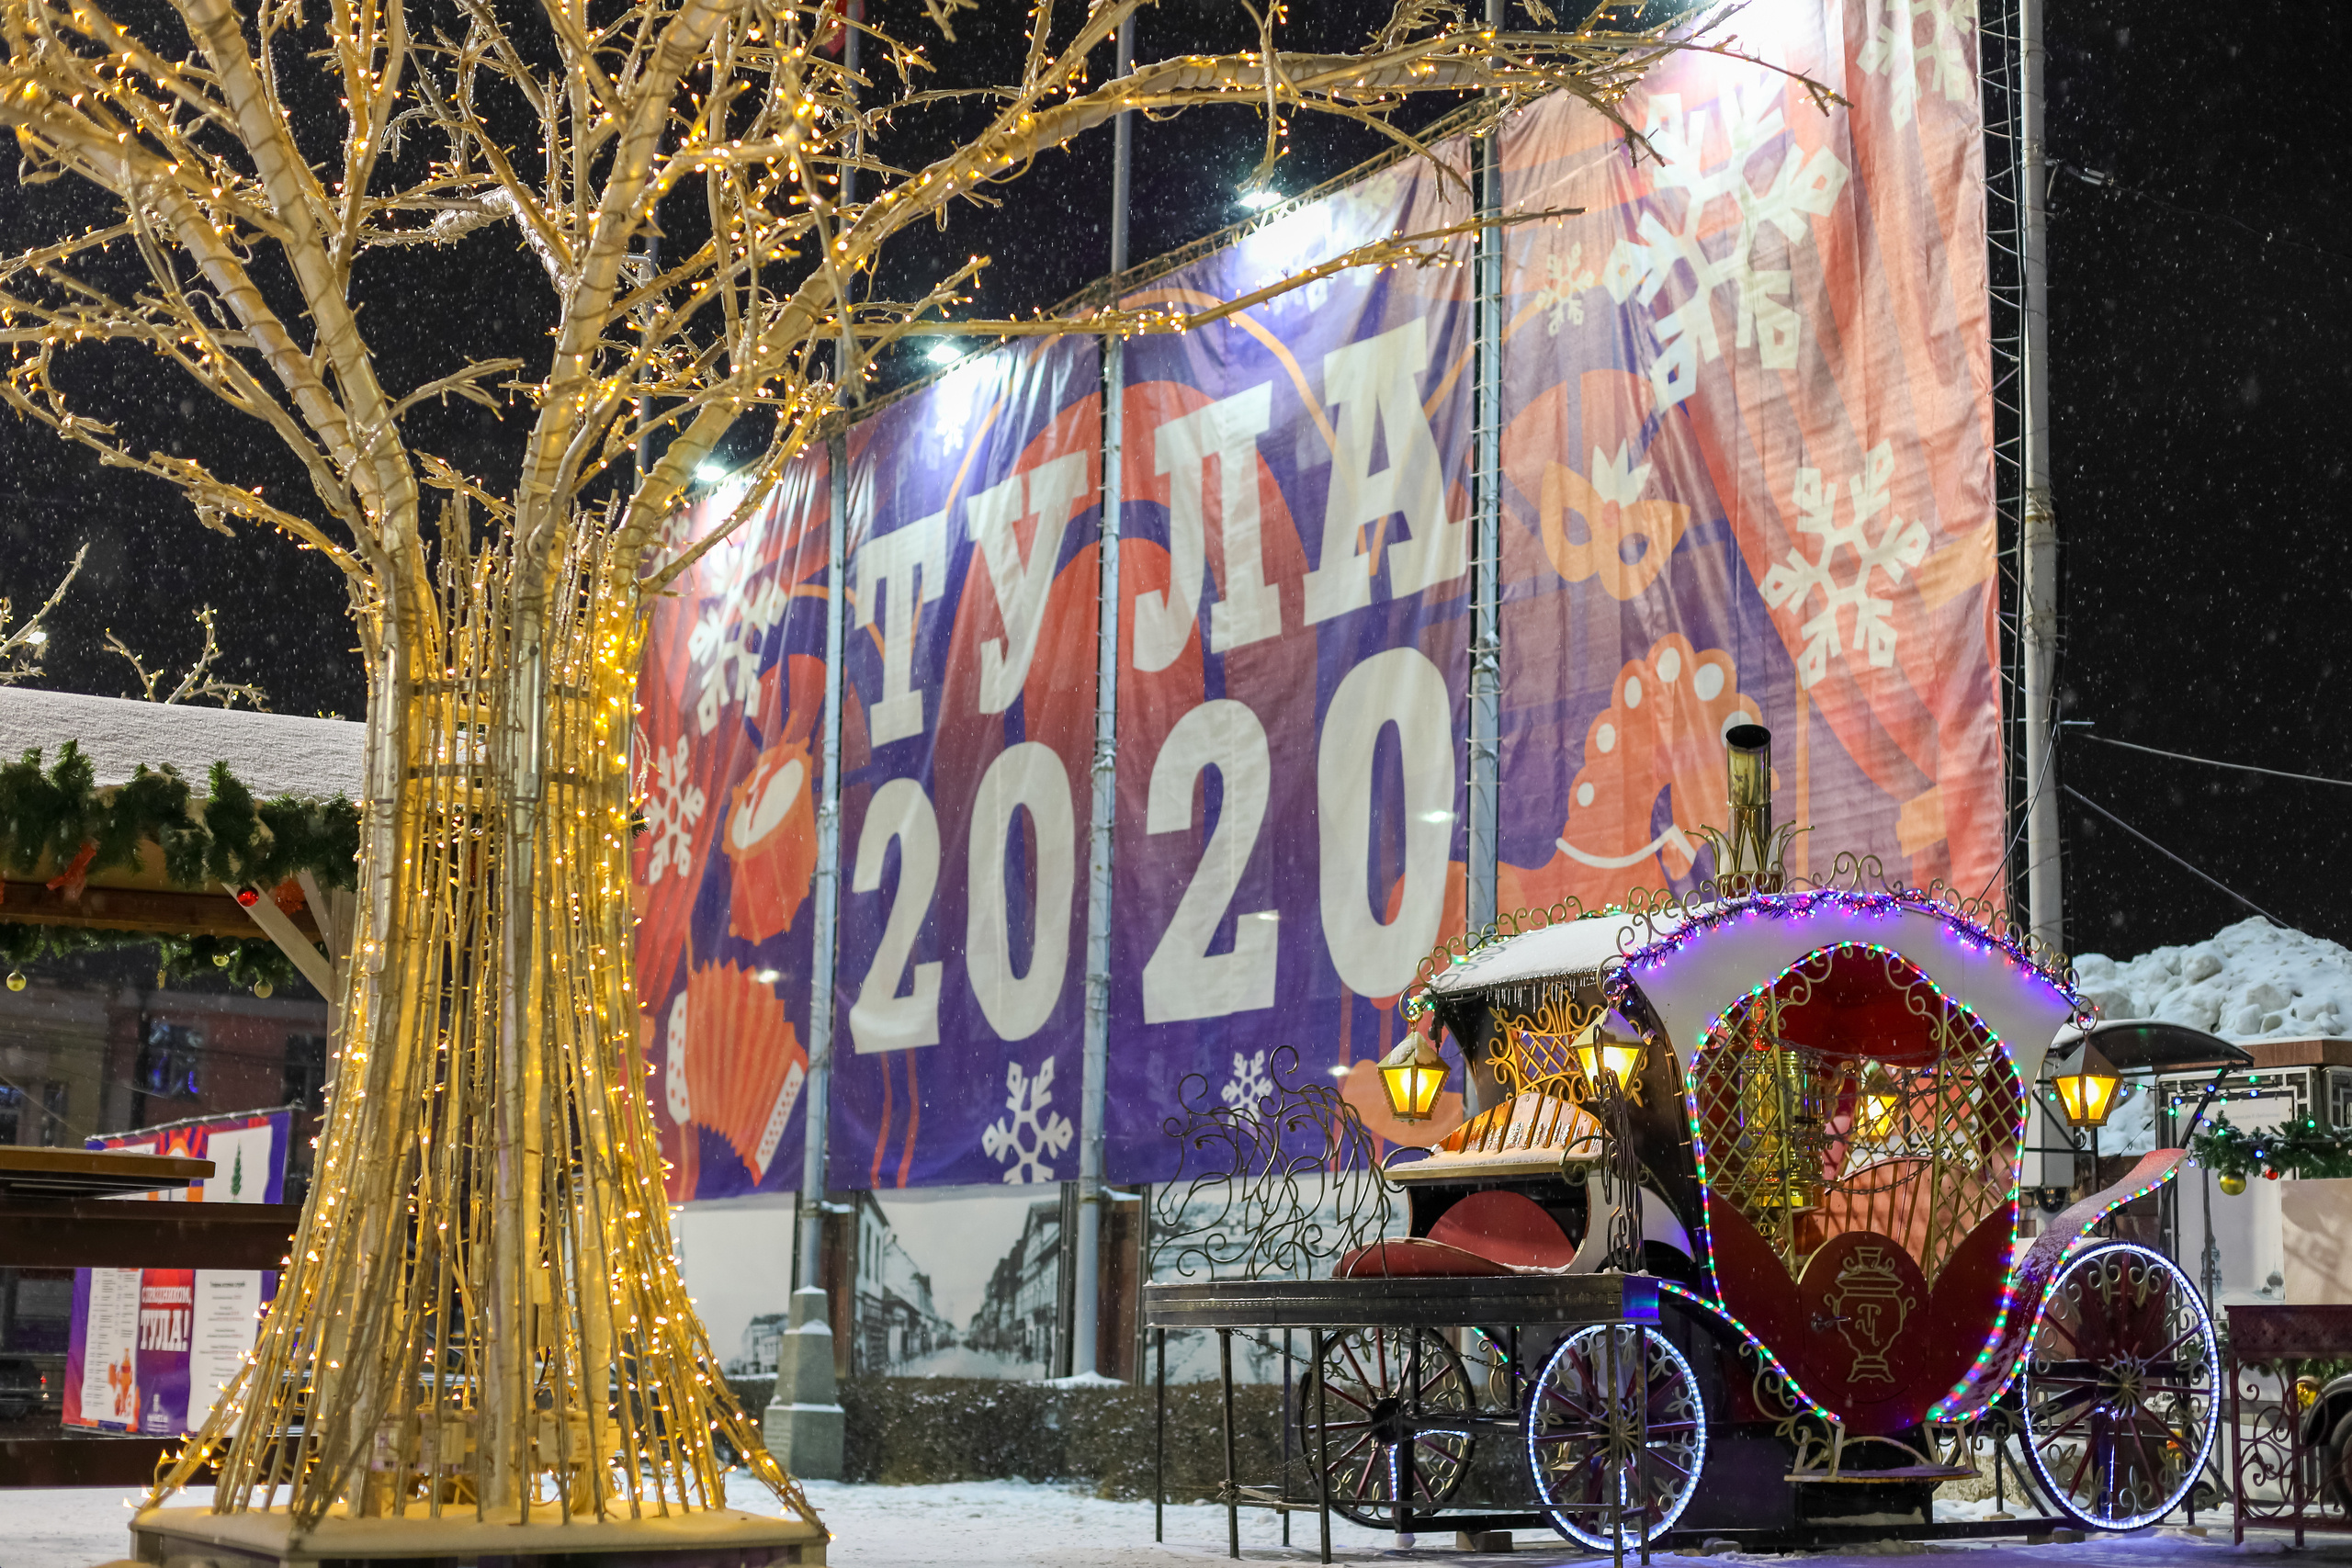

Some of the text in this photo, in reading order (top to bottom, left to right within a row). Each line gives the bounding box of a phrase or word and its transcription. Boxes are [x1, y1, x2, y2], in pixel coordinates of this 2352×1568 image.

[853, 317, 1468, 749] ТУЛА
[848, 646, 1455, 1055] 2020
[140, 1309, 190, 1351] ТУЛА!
